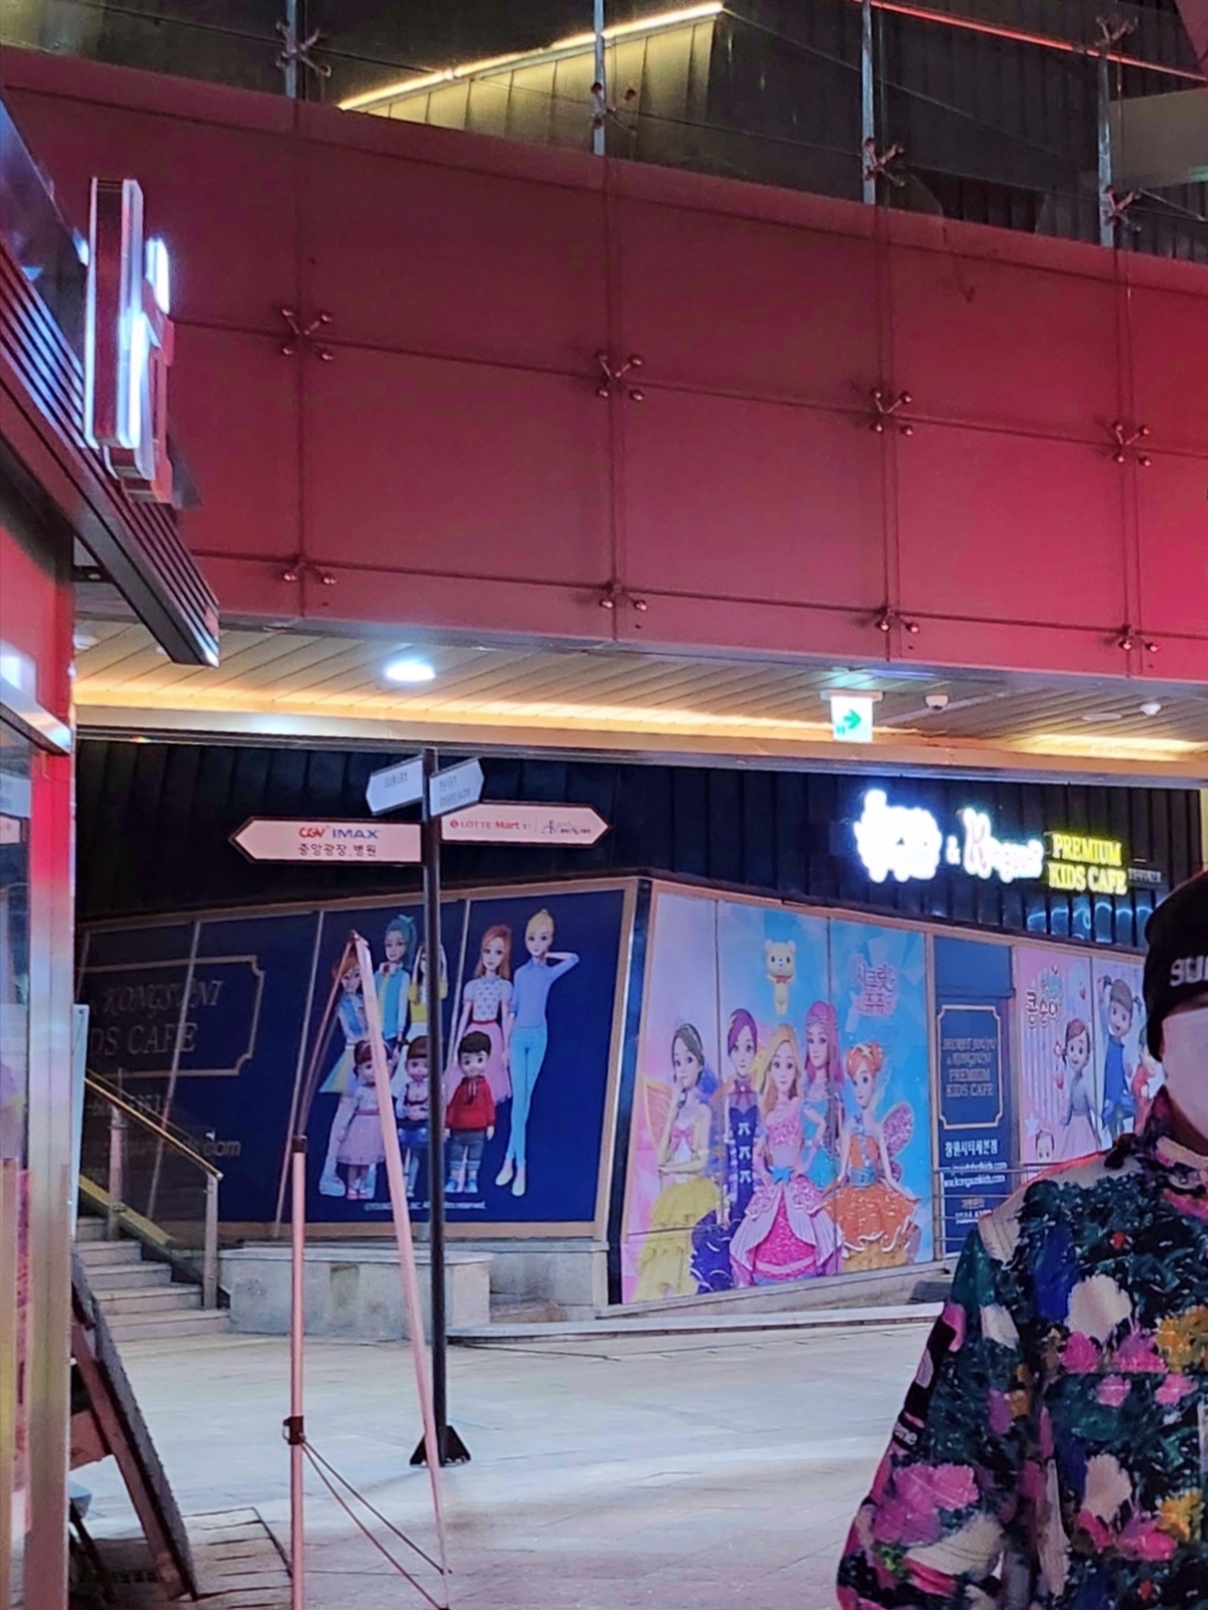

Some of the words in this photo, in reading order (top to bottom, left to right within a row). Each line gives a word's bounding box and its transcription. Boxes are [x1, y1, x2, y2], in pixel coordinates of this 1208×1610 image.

[298, 827, 326, 838] CGV
[332, 828, 379, 839] IMAX
[494, 820, 520, 830] Mart
[1052, 833, 1122, 867] PREMIUM
[1048, 862, 1086, 892] KIDS
[1087, 866, 1128, 896] CAFE
[103, 979, 224, 1018] KONGSNI
[1026, 990, 1062, 1027] 콩순이
[127, 1022, 198, 1056] CAFE
[946, 1084, 969, 1097] KIDS
[970, 1083, 994, 1096] CAFE
